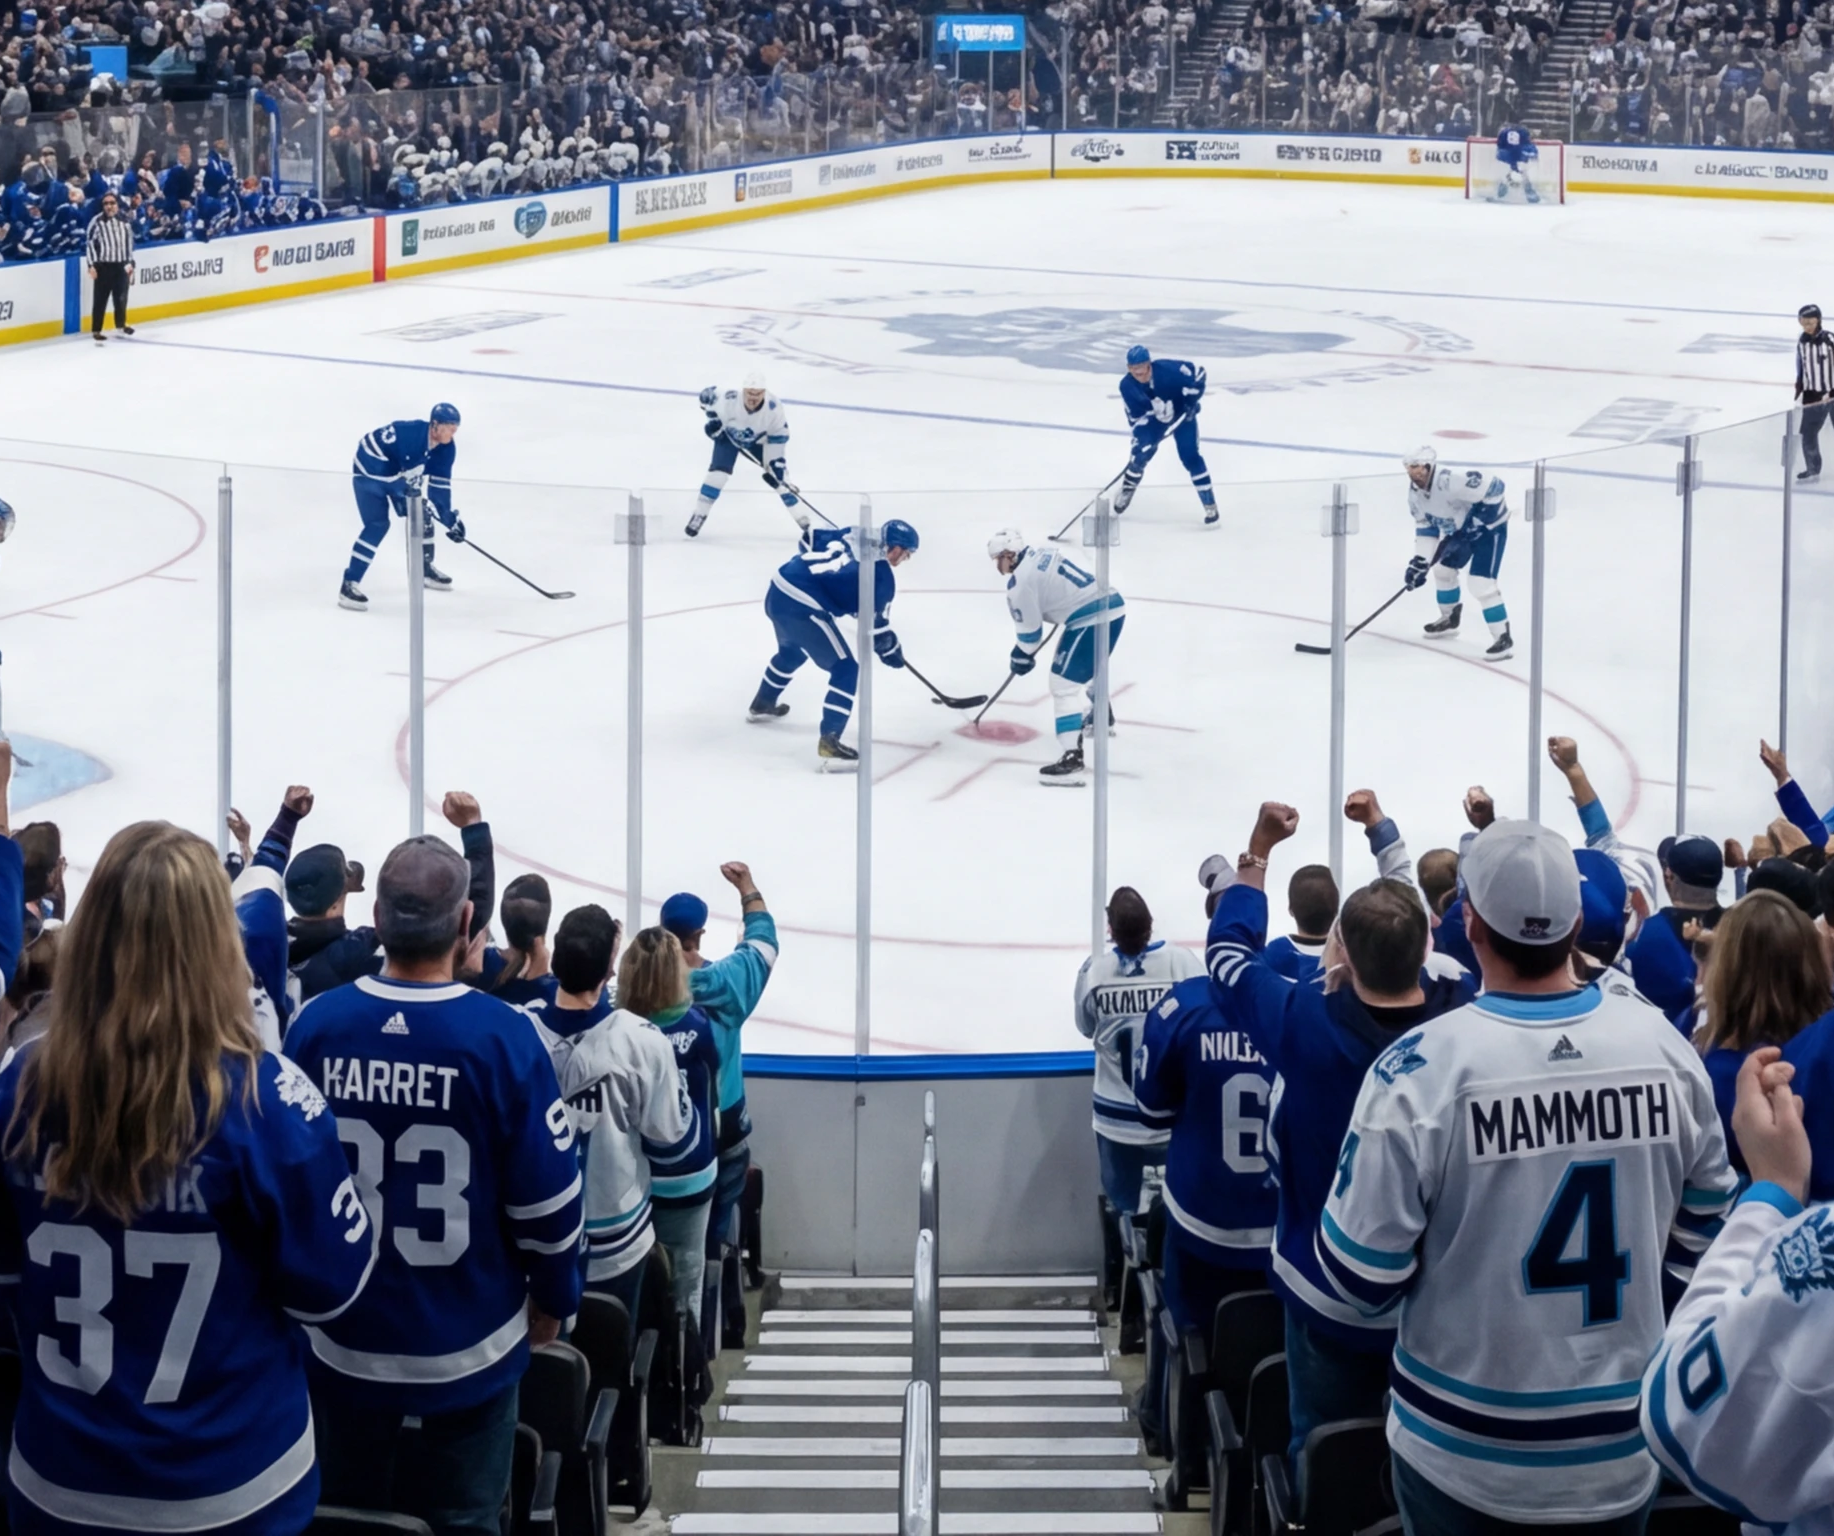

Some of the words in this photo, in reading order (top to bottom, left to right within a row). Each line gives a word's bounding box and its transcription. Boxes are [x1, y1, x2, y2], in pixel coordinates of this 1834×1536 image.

[1221, 1072, 1271, 1174] 6
[1470, 1082, 1670, 1157] MAMMOTH
[1521, 1157, 1632, 1329] 4
[27, 1222, 221, 1405] 37
